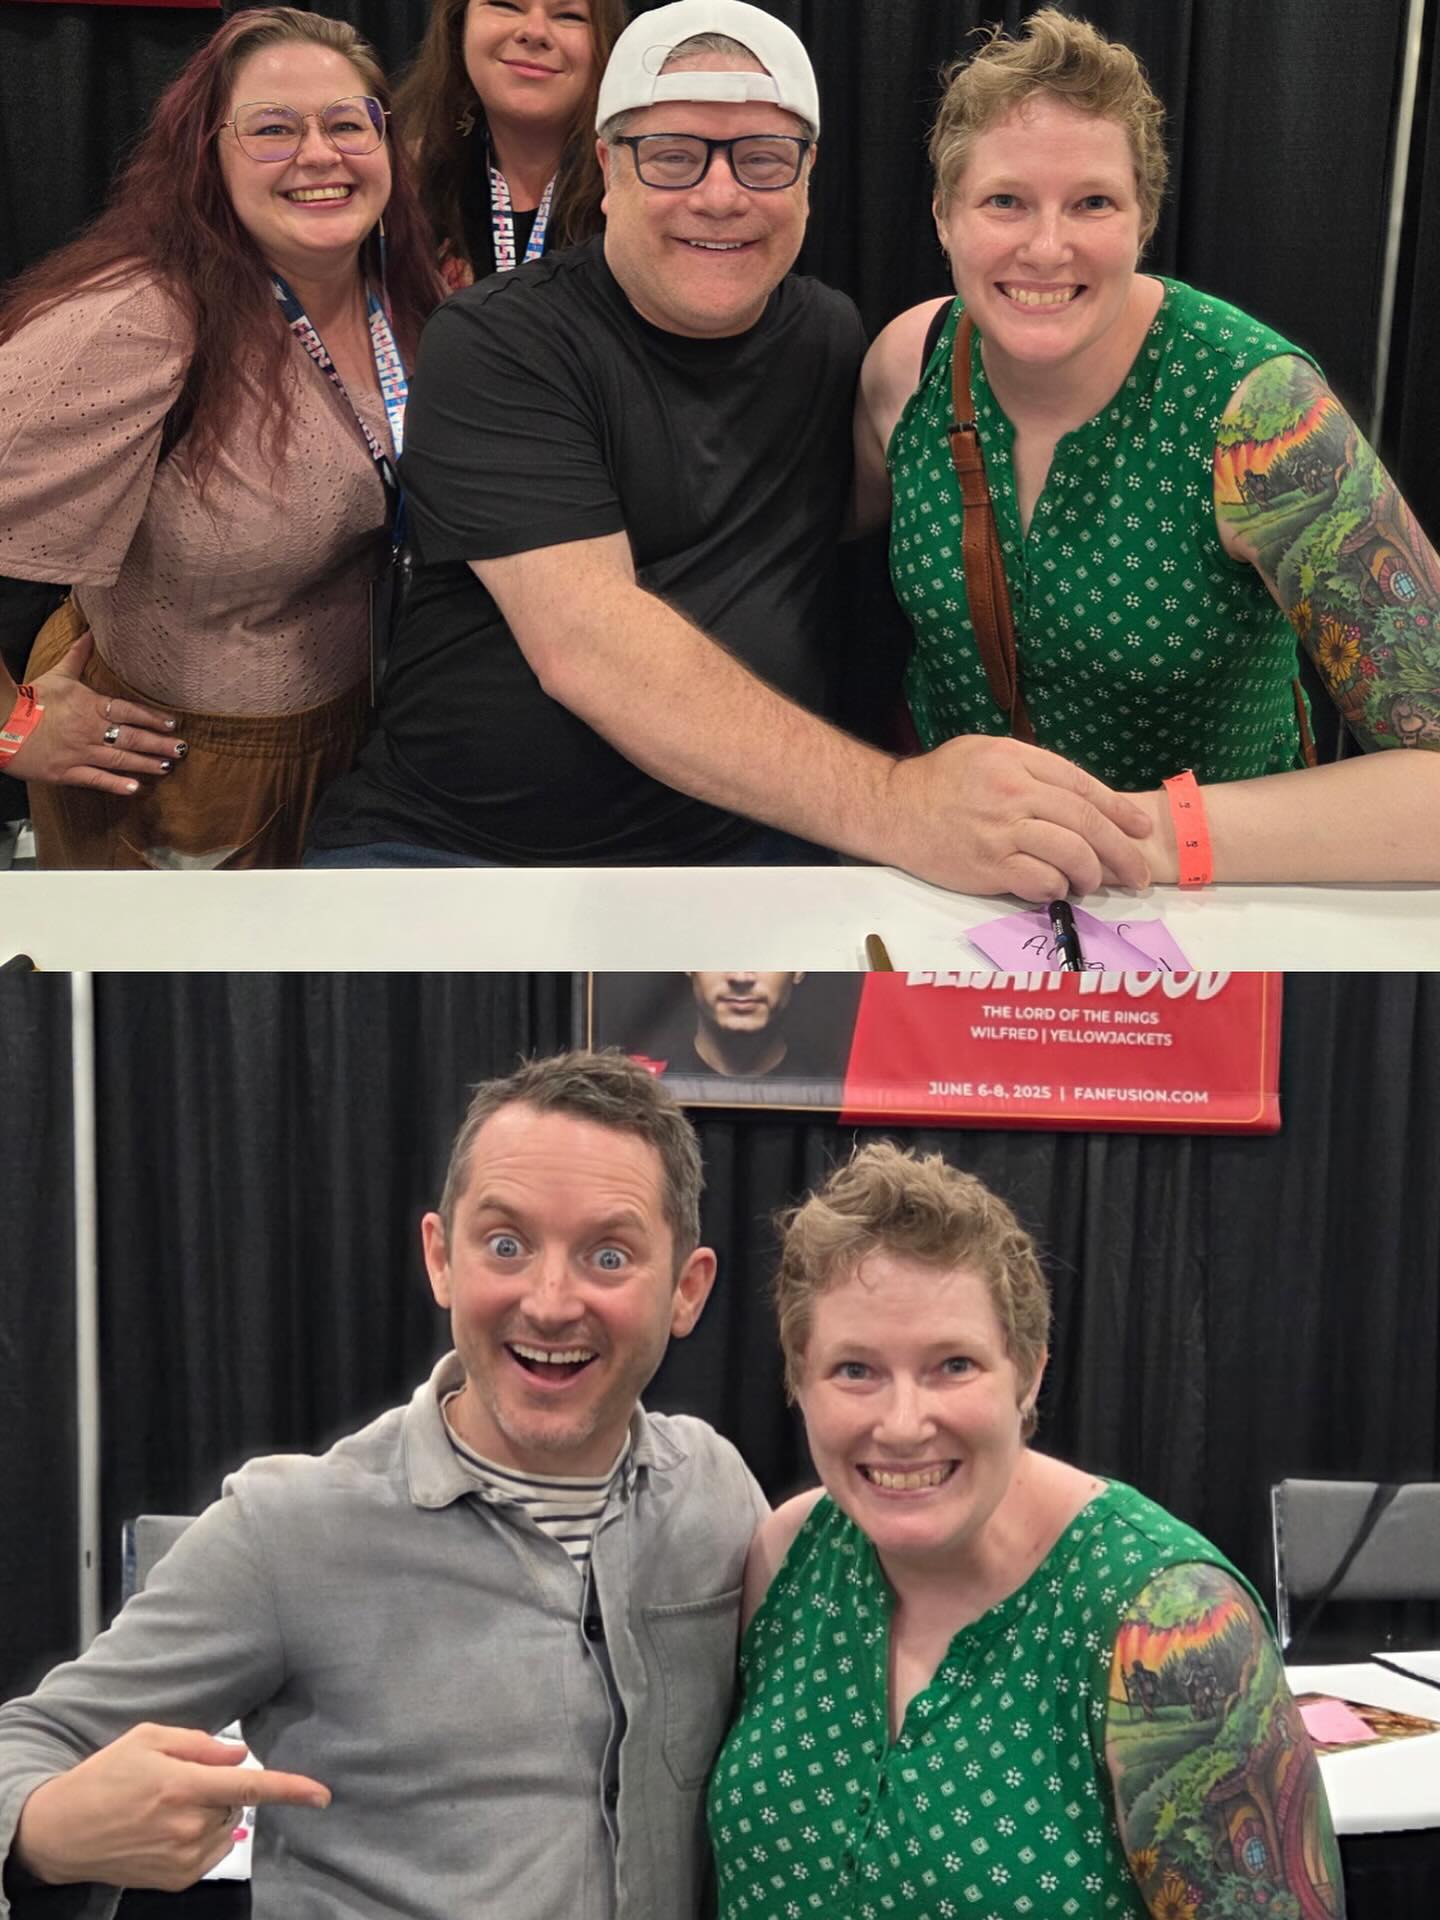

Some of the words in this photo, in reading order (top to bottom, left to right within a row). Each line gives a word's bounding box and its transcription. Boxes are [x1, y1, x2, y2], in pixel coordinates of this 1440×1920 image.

[530, 175, 557, 244] FUSIO
[289, 315, 332, 368] FAN
[369, 309, 409, 400] FUSION
[982, 1005, 1011, 1019] THE
[1015, 1006, 1055, 1021] LORD
[1059, 1008, 1080, 1022] OF
[1082, 1009, 1111, 1023] THE
[1114, 1010, 1159, 1025] RINGS
[970, 1026, 1038, 1041] WILFRED
[1050, 1029, 1173, 1046] YELLOWJACKETS
[928, 1082, 972, 1097] JUNE
[978, 1083, 1009, 1099] 6-8,
[1013, 1084, 1051, 1099] 2025
[1074, 1087, 1209, 1104] FANFUSION.COM
